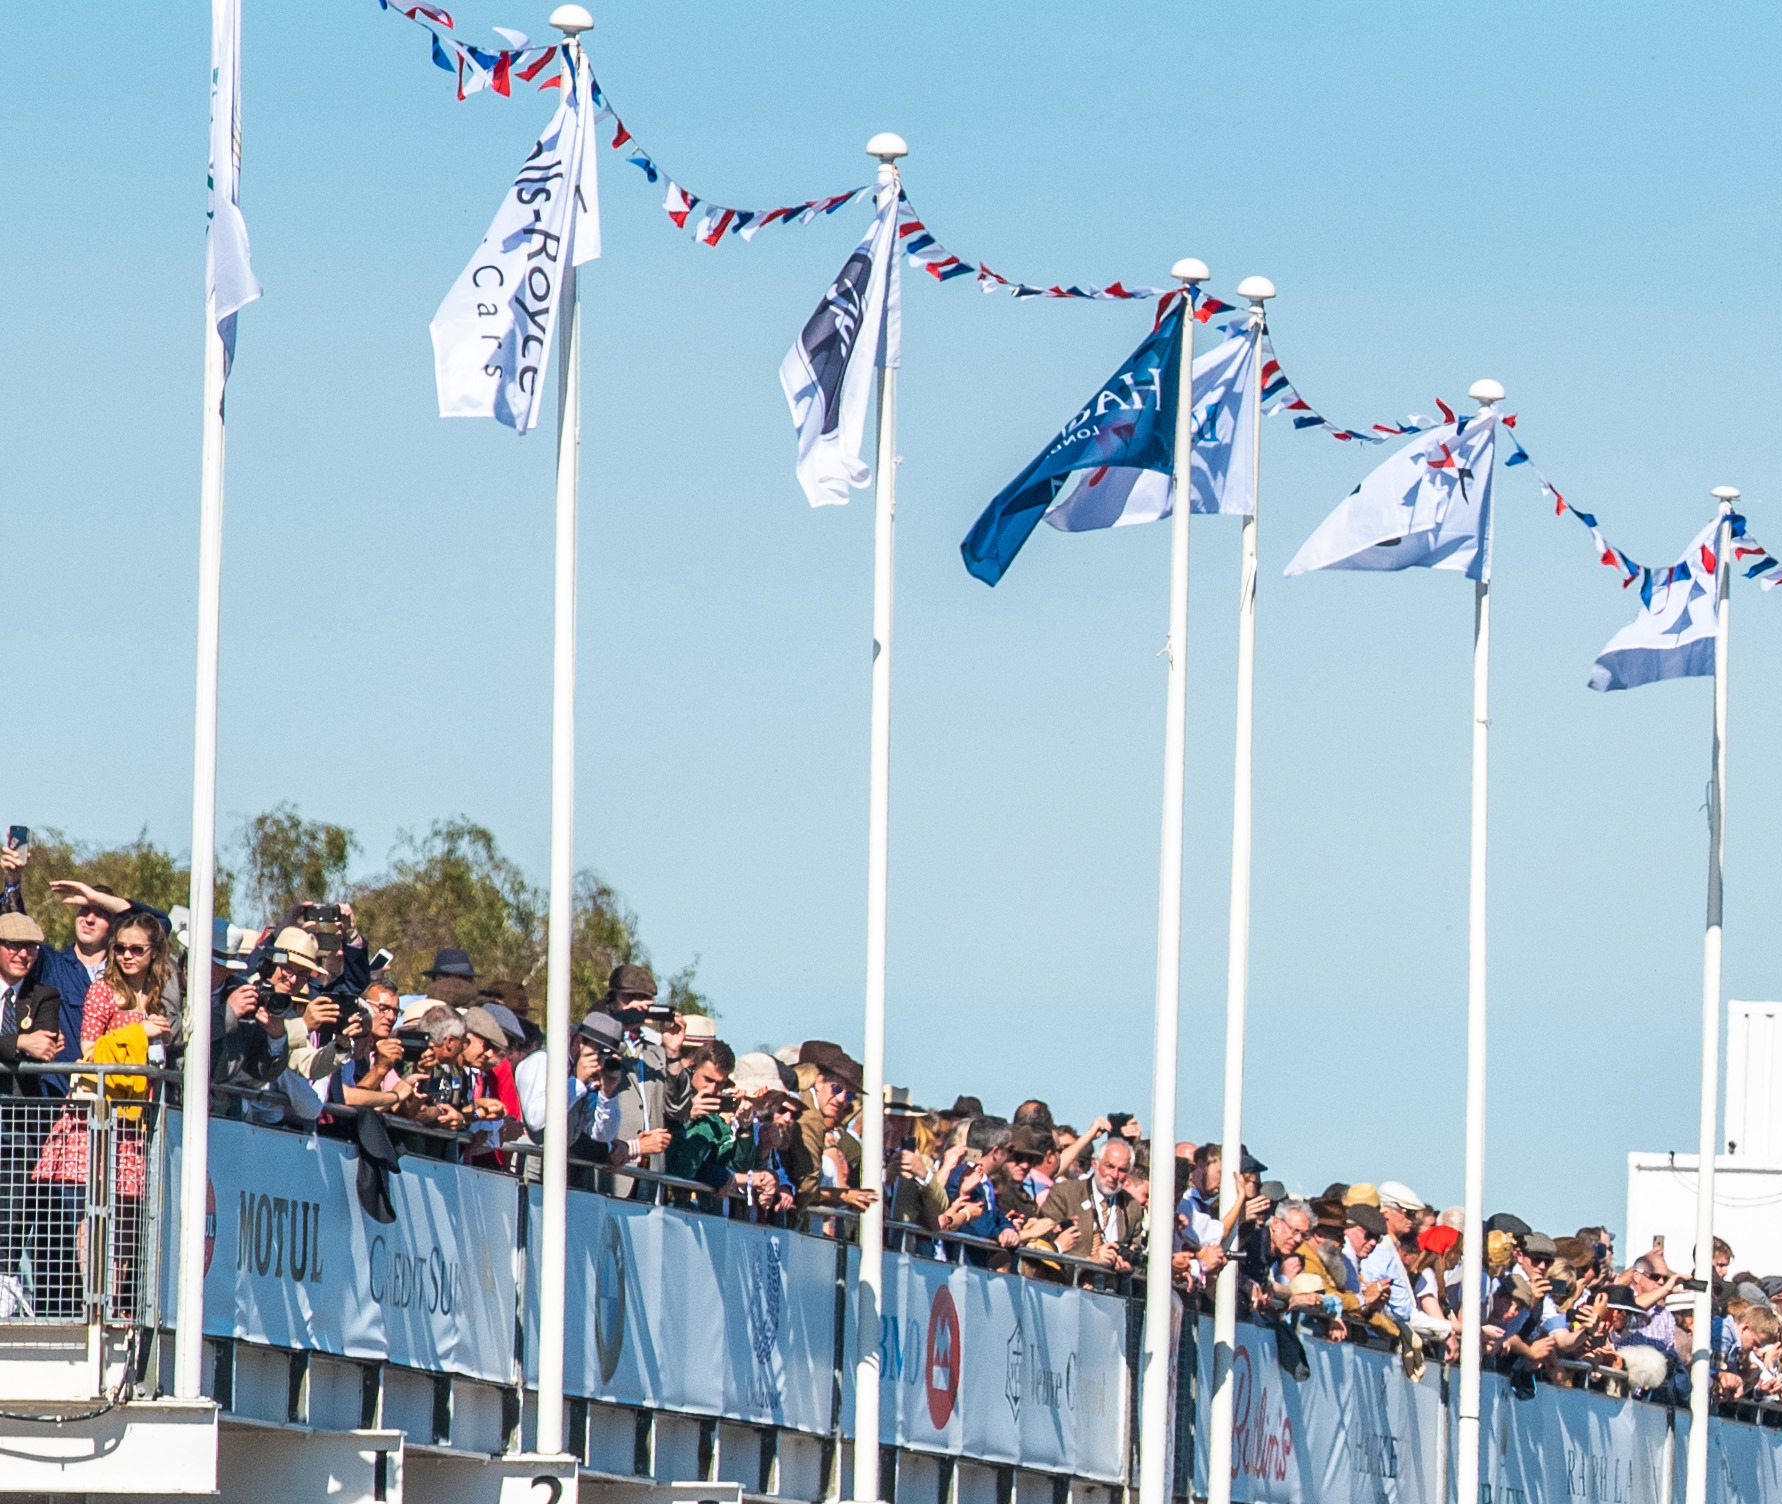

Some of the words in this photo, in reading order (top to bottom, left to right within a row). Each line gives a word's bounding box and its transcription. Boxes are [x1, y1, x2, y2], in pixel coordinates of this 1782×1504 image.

[472, 265, 504, 379] Cars
[237, 1190, 323, 1283] MOTUL
[375, 1450, 388, 1501] 1
